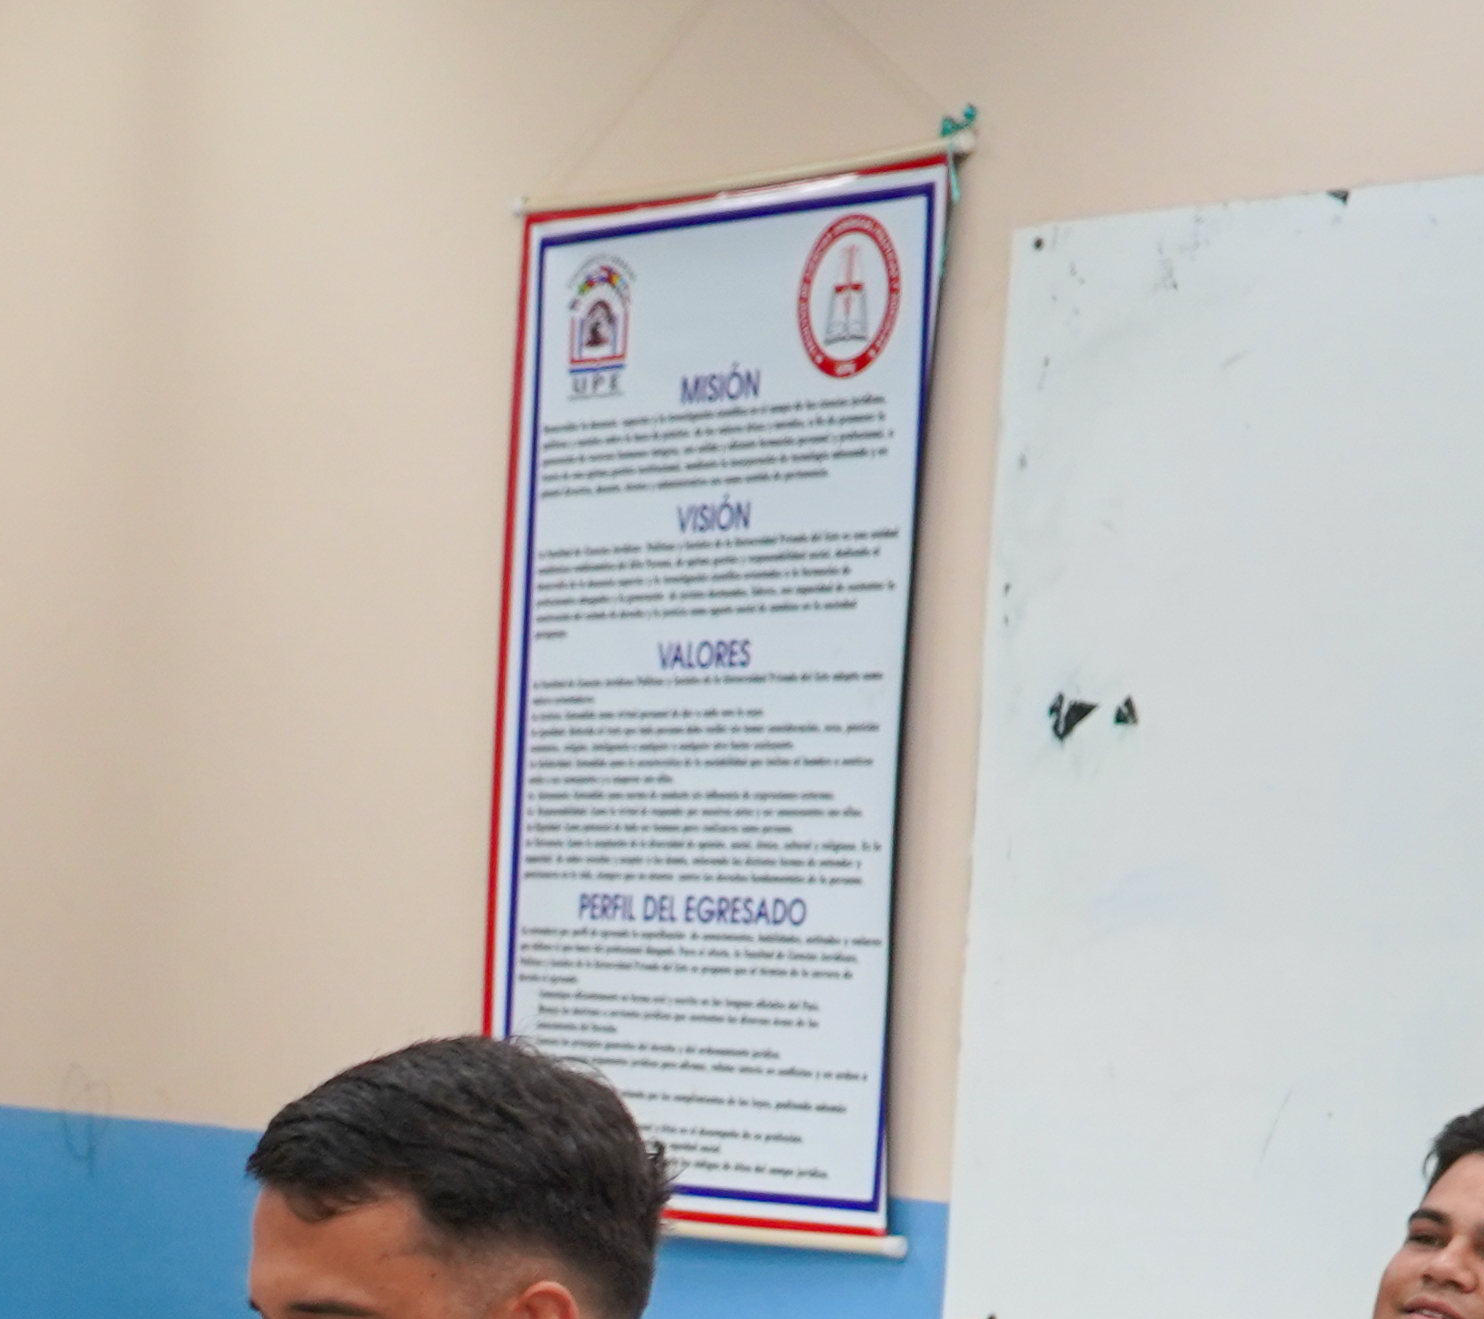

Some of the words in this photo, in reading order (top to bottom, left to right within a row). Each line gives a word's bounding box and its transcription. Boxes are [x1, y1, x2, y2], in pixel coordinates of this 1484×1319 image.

[680, 361, 760, 403] MISIÓN
[676, 494, 751, 532] VISIÓN
[658, 639, 752, 670] VALORES
[578, 893, 636, 921] PERFIL
[643, 896, 678, 923] DEL
[684, 896, 807, 926] EGRESADO
